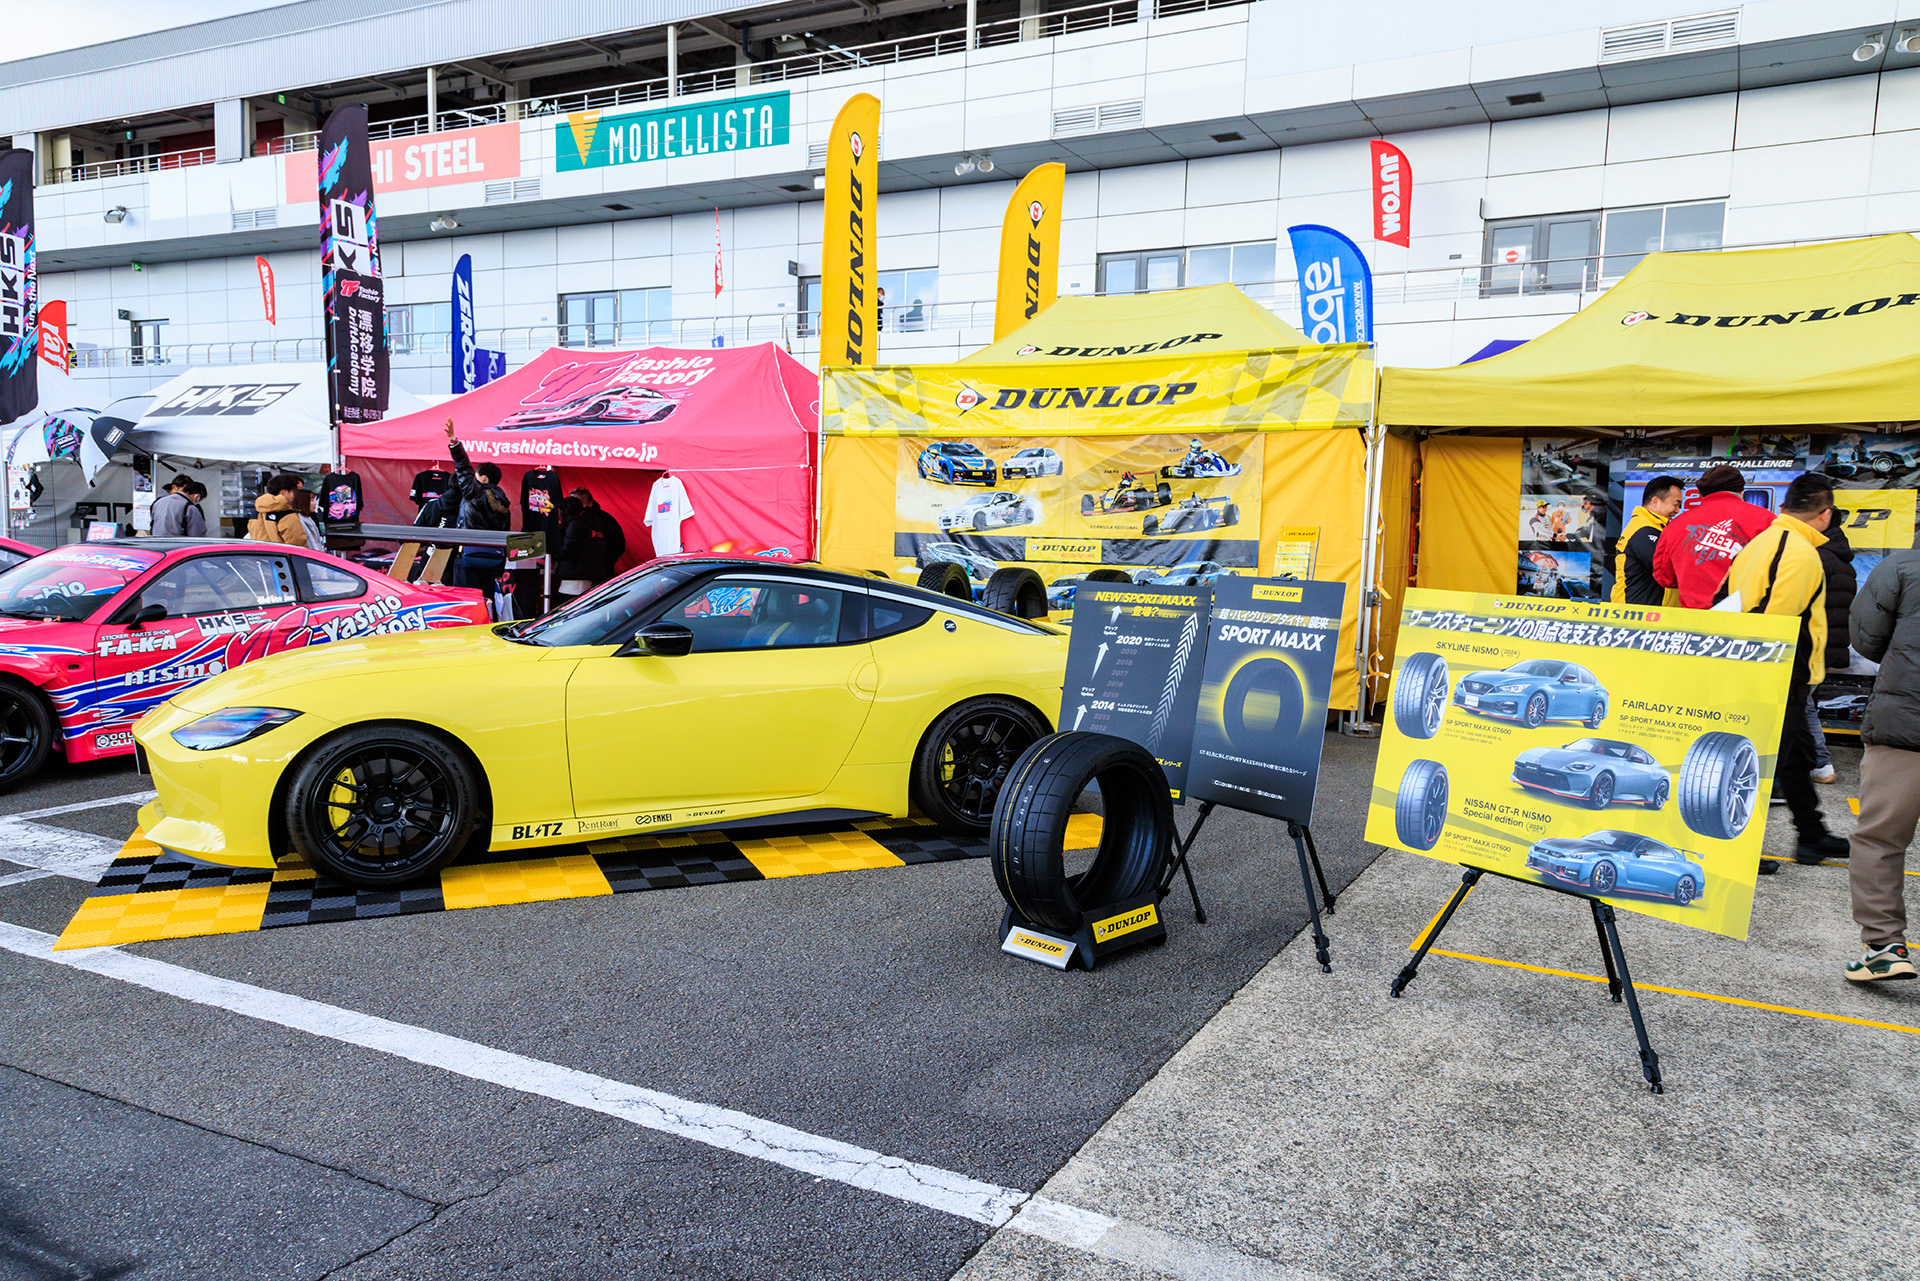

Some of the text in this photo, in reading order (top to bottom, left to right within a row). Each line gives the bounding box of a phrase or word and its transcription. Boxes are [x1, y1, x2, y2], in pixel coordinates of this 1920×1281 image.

[609, 104, 774, 165] MODELLISTA
[405, 138, 484, 181] STEEL
[335, 203, 357, 270] KS
[26, 250, 37, 332] Tune the Next
[348, 306, 360, 396] DriftAcademy
[1045, 333, 1223, 357] DUNLOP
[625, 356, 714, 372] Yashio
[619, 366, 714, 387] Factory
[169, 384, 298, 408] HKS
[989, 382, 1197, 411] DUNLOP
[461, 438, 658, 462] ww.yashiofactory.co.jp
[1699, 461, 1728, 469] SLOT
[1729, 460, 1794, 469] CHALLENGE
[1042, 544, 1096, 553] DUNLOP
[1095, 591, 1197, 607] NEW SPORT MAXX
[1262, 590, 1299, 598] DUNLOP
[322, 595, 402, 642] Yashio
[1504, 602, 1566, 613] DUNLOP
[1588, 607, 1661, 622] nismo
[200, 613, 246, 631] HKS
[101, 633, 129, 641] STICKER
[1116, 636, 1142, 645] 2020
[1218, 625, 1327, 652] SPORT MAXX
[1436, 641, 1471, 653] SKYLINE
[1471, 646, 1500, 656] NISMO
[124, 660, 223, 687] nismo
[1102, 691, 1119, 699] 2015
[1091, 700, 1116, 711] 2014
[1622, 699, 1674, 714] FAIRLADY
[1676, 706, 1683, 715] Z
[1685, 708, 1722, 721] NISMO
[1093, 713, 1111, 721] 2013
[1630, 716, 1653, 724] SPORT
[1654, 720, 1677, 728] MAXX
[1678, 723, 1703, 732] GT600
[1089, 724, 1107, 732] 2012
[1454, 720, 1473, 728] SPORT
[1474, 723, 1491, 731] MAXX
[1492, 726, 1512, 735] GT600
[111, 739, 132, 747] CLU
[1214, 780, 1283, 800] COMING SOON
[1462, 807, 1493, 822] Special
[1494, 814, 1524, 828] edition
[1464, 798, 1552, 824] NISSAN GT-R NISMO
[578, 818, 620, 833] PentRoof
[1453, 833, 1471, 842] SPORT
[1472, 838, 1490, 847] MAXX
[1491, 843, 1511, 852] GT600
[1107, 911, 1151, 933] DUNLOP
[1023, 938, 1062, 953] DUNLOP
